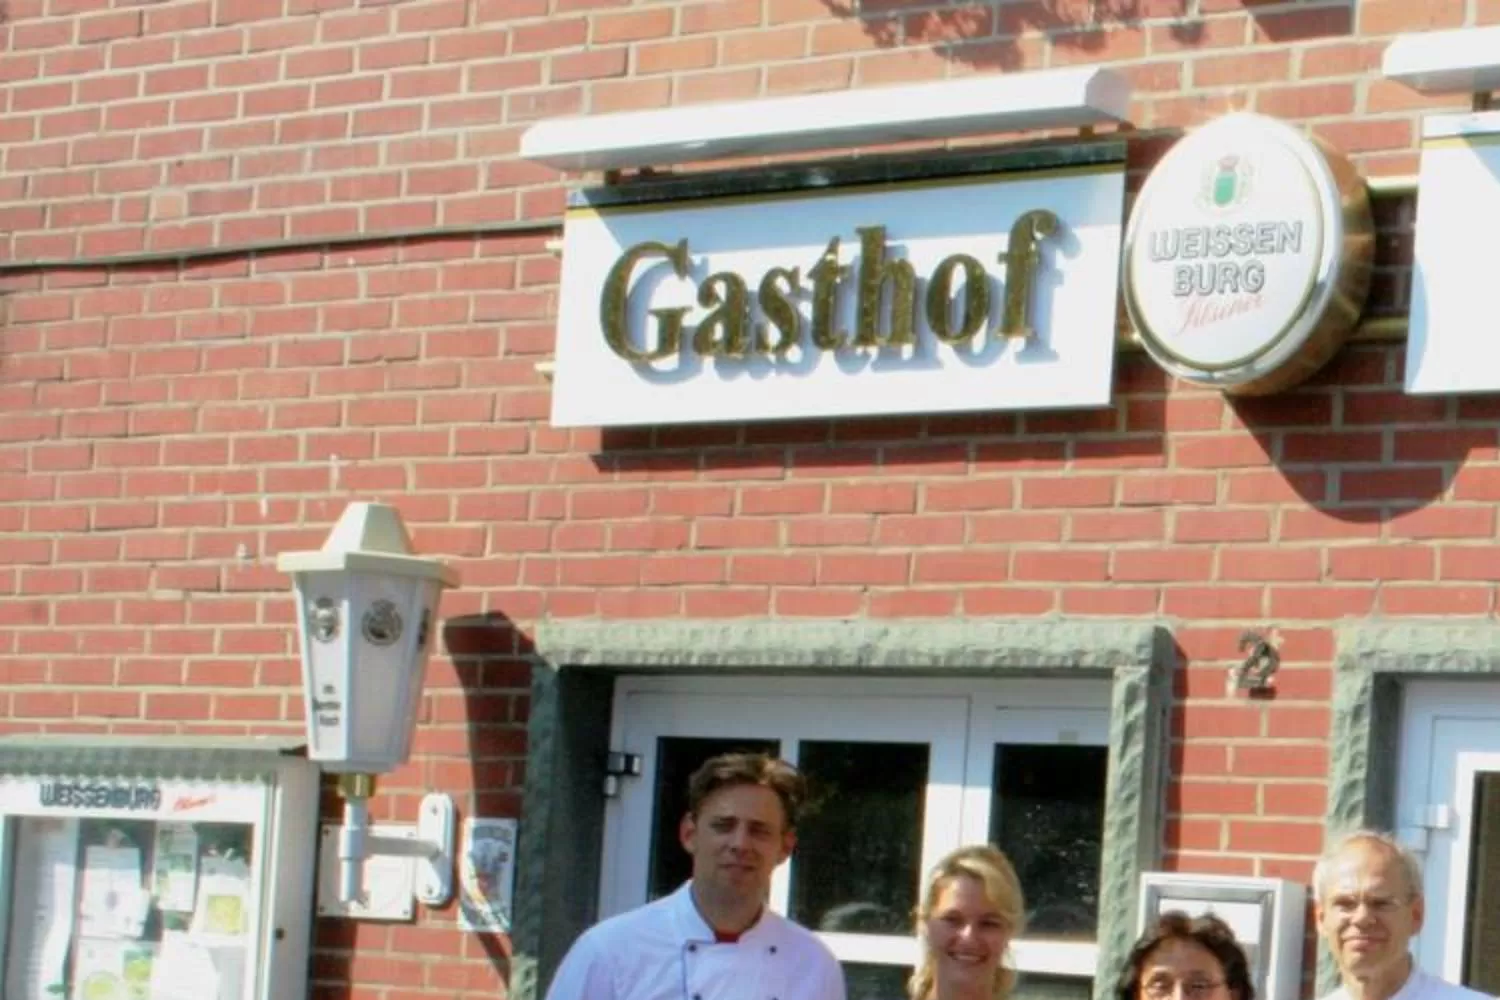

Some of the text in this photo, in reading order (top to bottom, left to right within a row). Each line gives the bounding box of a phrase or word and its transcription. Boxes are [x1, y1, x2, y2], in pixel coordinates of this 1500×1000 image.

[1149, 220, 1304, 262] WEISSEN
[600, 208, 1060, 364] Gasthof
[1172, 259, 1266, 297] BURG
[1238, 631, 1274, 690] 2
